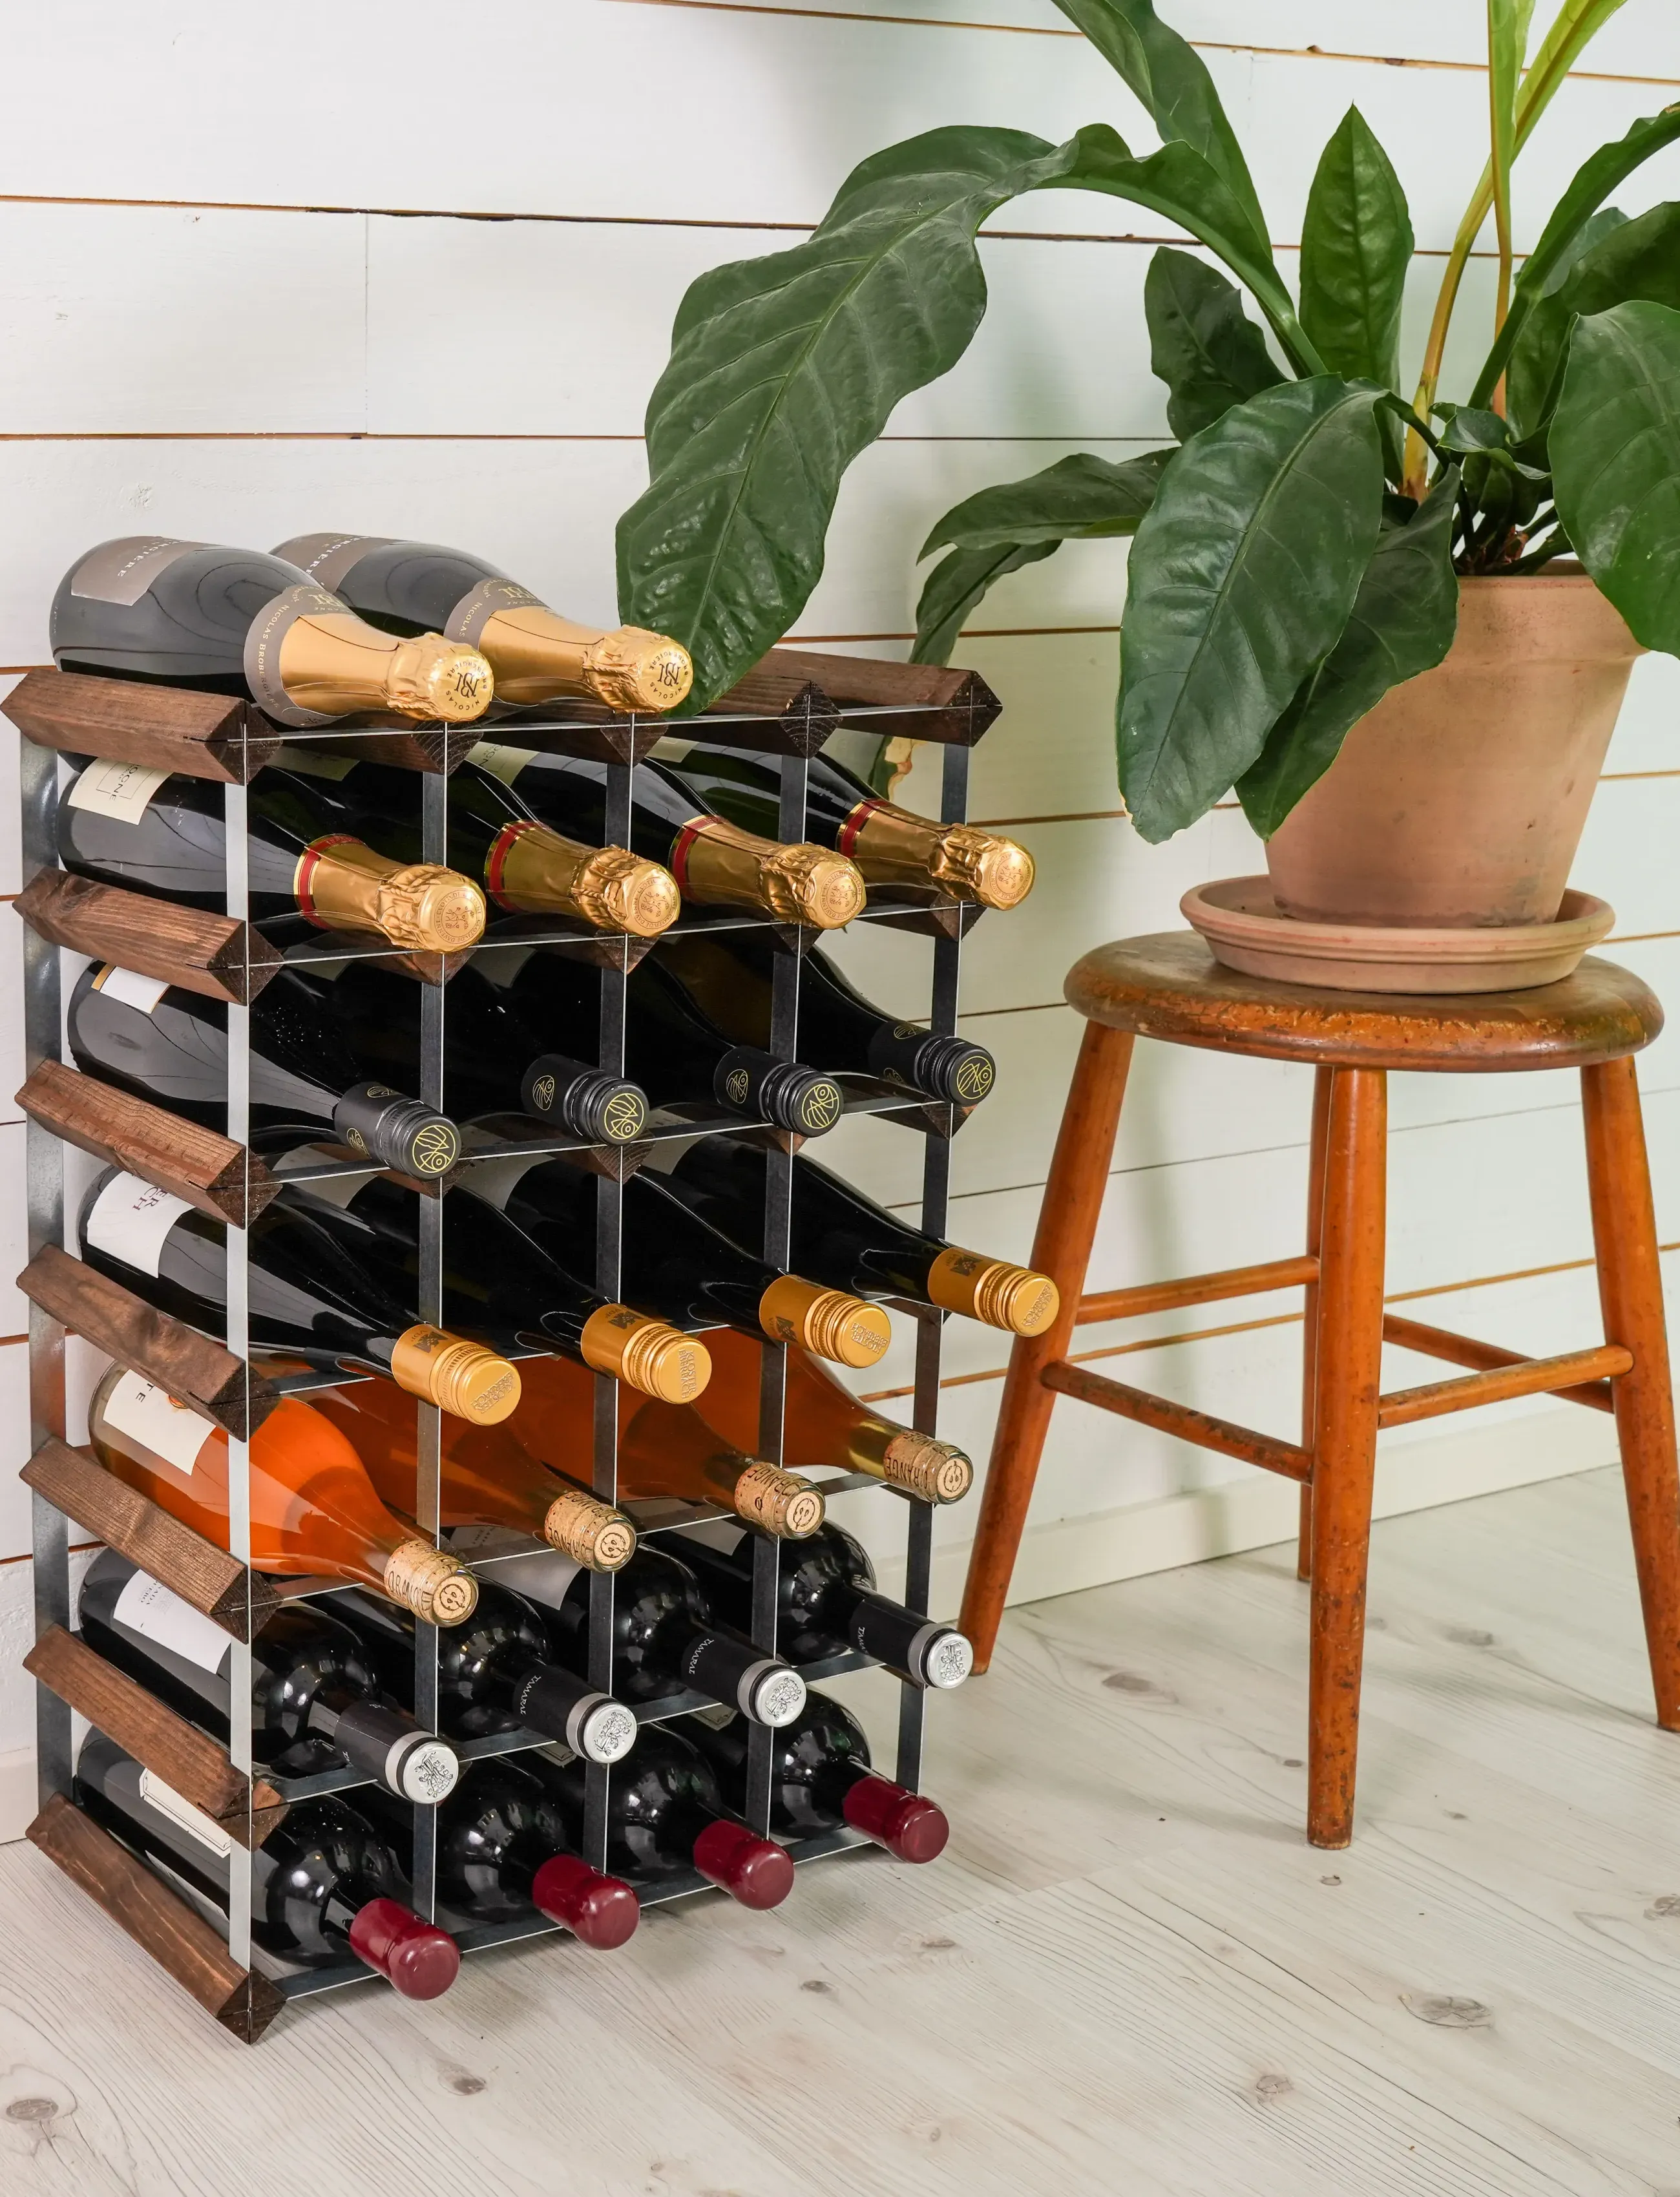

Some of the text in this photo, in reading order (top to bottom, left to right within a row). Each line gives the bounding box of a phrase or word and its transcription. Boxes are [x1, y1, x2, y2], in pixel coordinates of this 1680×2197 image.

[262, 605, 289, 640] NICOLAS
[459, 602, 483, 636] NICOLAS
[446, 690, 479, 710] NICOLAS
[650, 682, 682, 699] NICOLAS
[885, 1457, 928, 1489] ORANGE
[388, 1571, 433, 1611] ORANGE
[689, 1639, 714, 1674] TAMARAL
[520, 1676, 541, 1715] TAMARAL
